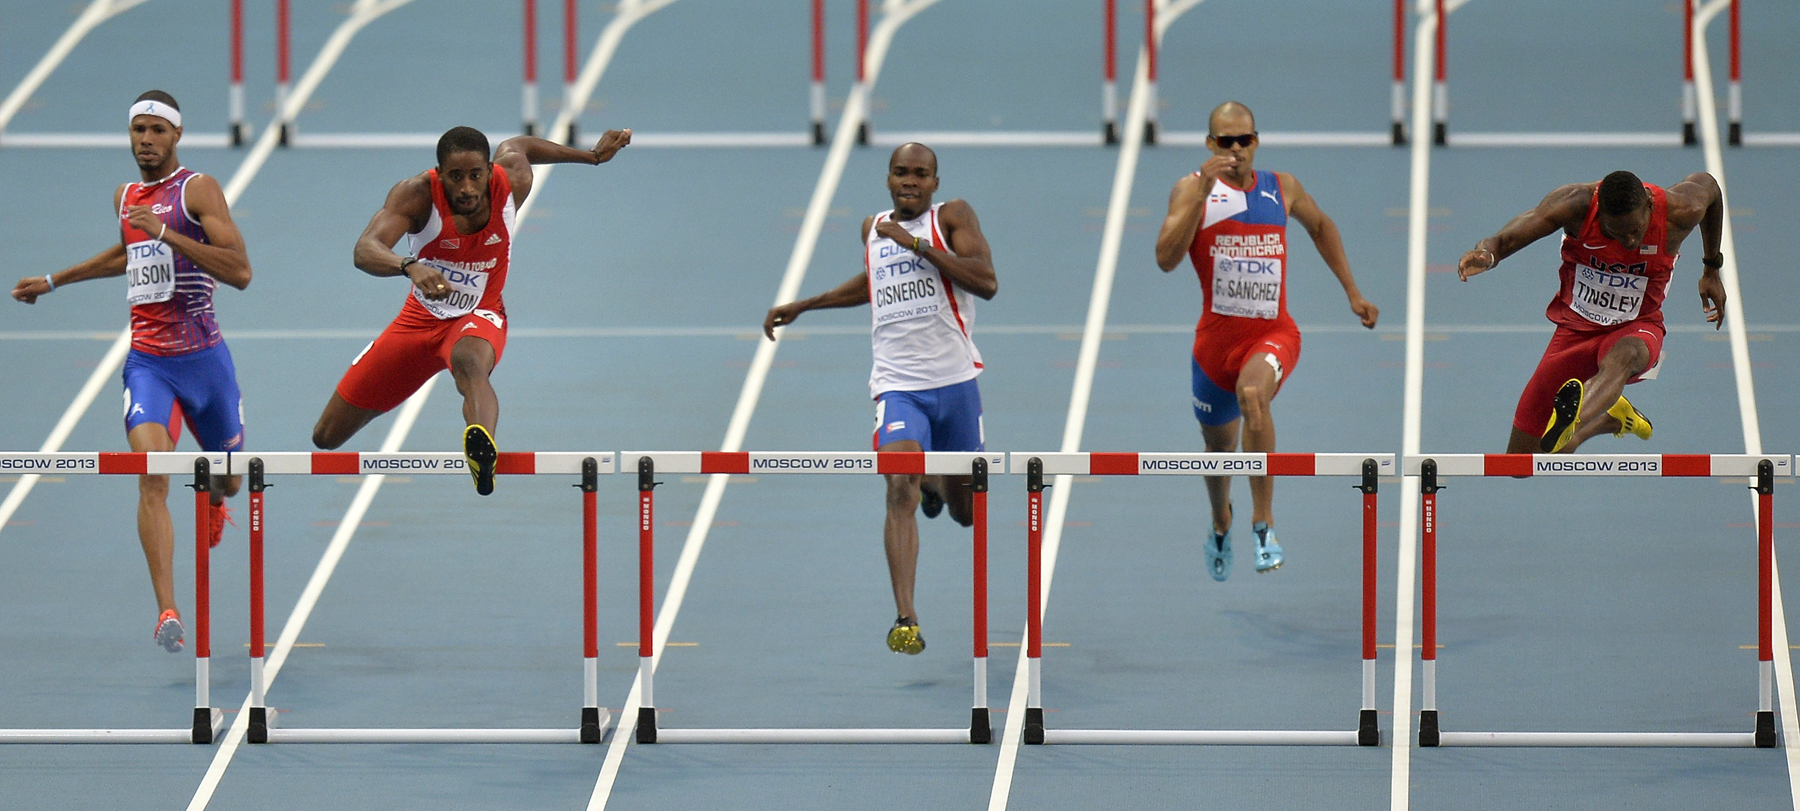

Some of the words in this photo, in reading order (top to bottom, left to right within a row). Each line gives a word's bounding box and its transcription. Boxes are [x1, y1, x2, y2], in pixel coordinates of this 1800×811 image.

[132, 243, 165, 259] TDK
[436, 264, 480, 288] TDK
[886, 258, 926, 277] TDK
[1233, 260, 1275, 275] TDK
[1227, 276, 1279, 301] SÁNCHEZ
[1595, 271, 1640, 290] TDK
[876, 278, 936, 308] CISNEROS
[1577, 281, 1640, 313] TINSLEY
[877, 309, 915, 322] MOSCOW
[916, 304, 938, 315] 2013
[1573, 301, 1611, 324] MOSCOW
[0, 459, 52, 469] SCOW
[56, 459, 95, 469] 2013
[363, 459, 439, 469] MOSCOW
[443, 459, 468, 469] 20
[753, 459, 829, 469] MOSCOW
[833, 459, 873, 469] 2013
[1142, 460, 1219, 470] MOSCOW
[1223, 460, 1263, 470] 2013
[1537, 461, 1614, 471] MOSCOW
[1618, 461, 1658, 471] 2013
